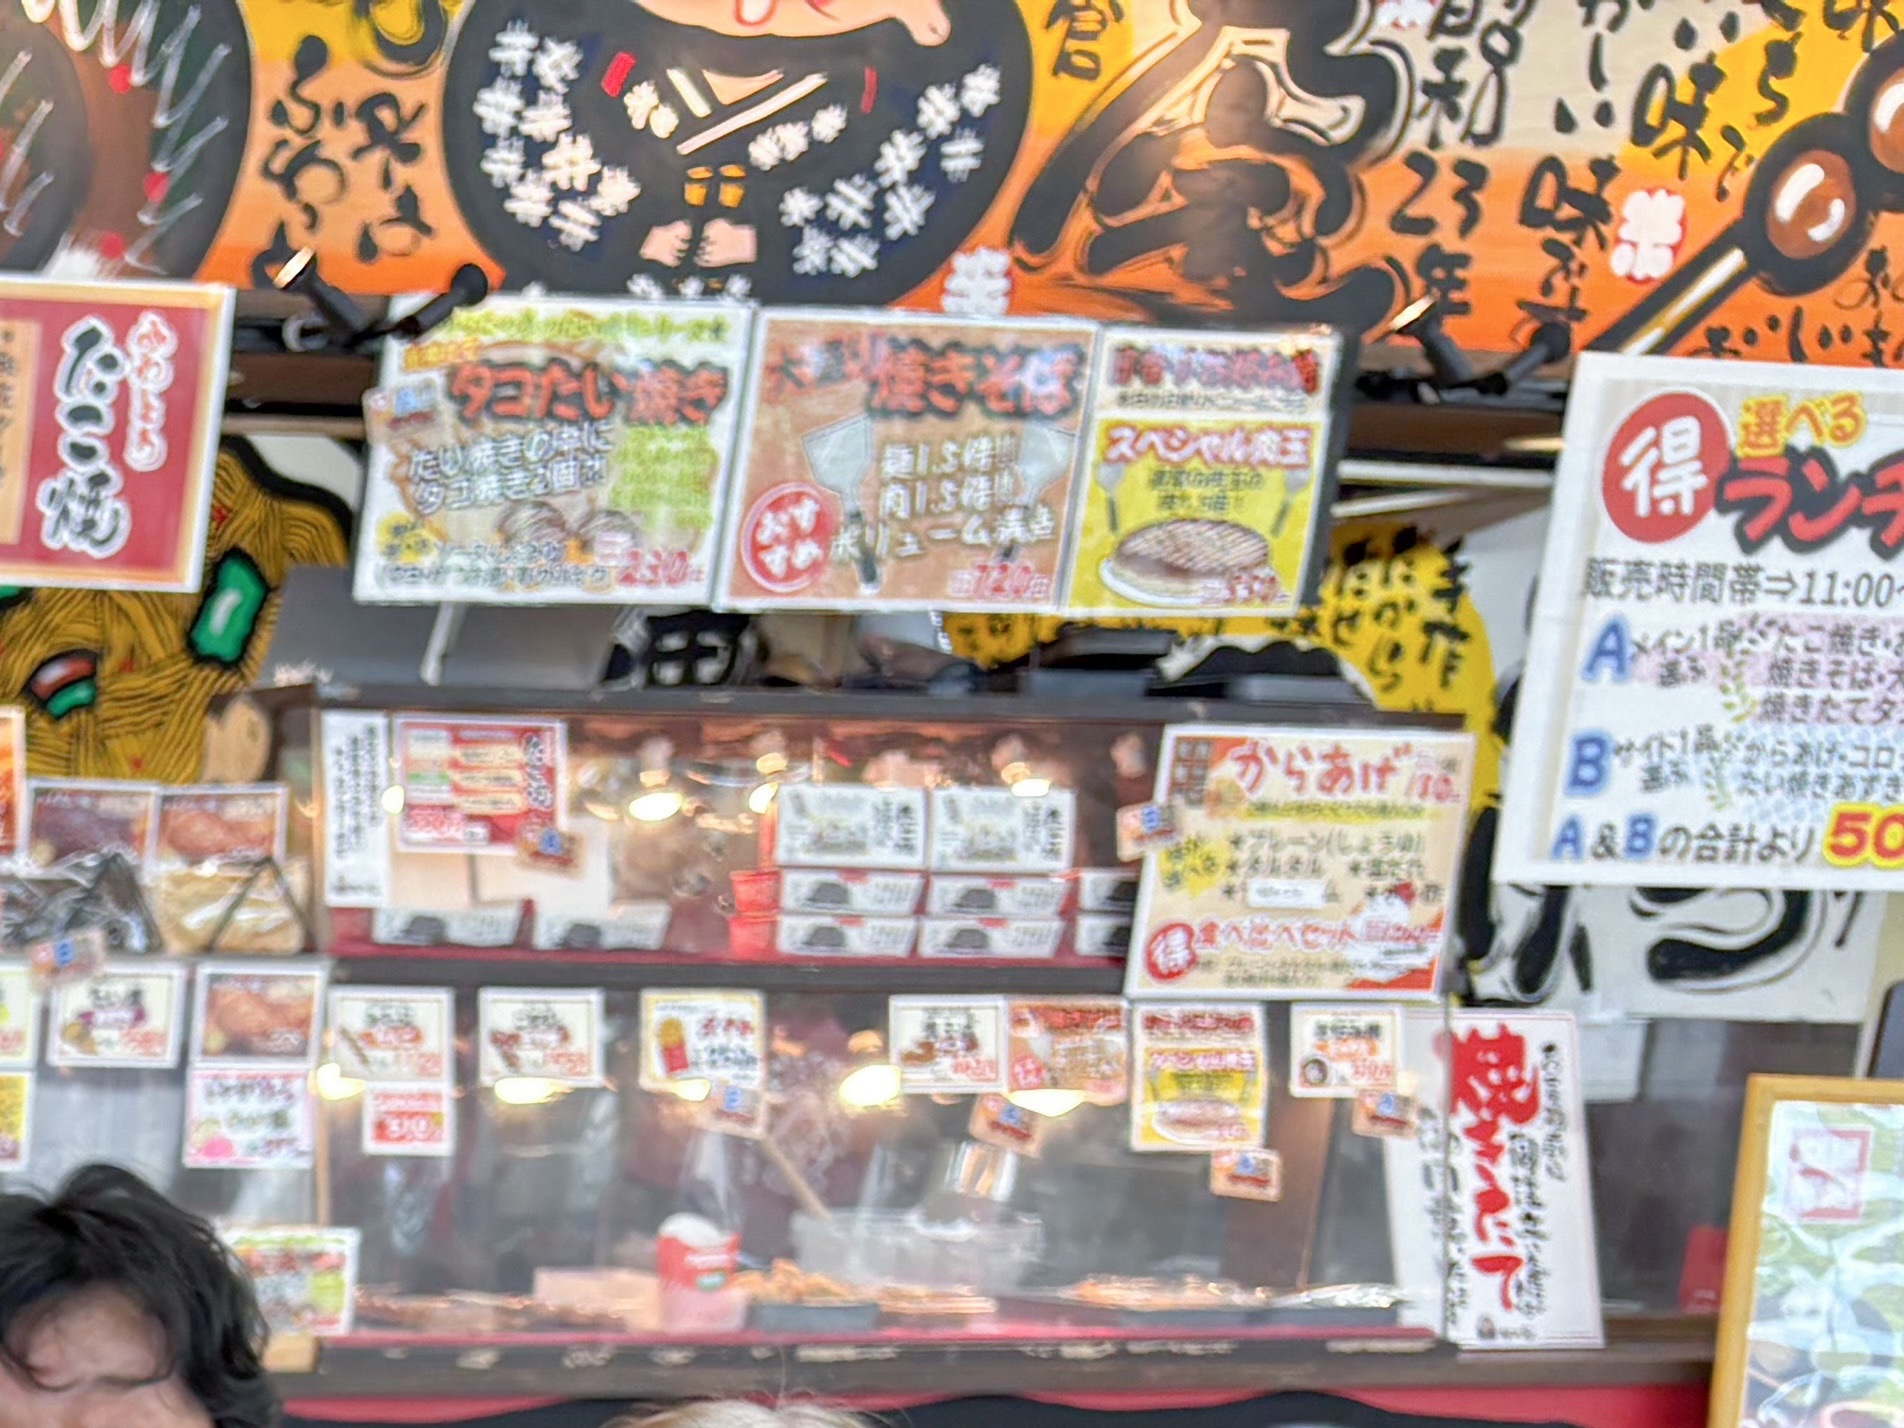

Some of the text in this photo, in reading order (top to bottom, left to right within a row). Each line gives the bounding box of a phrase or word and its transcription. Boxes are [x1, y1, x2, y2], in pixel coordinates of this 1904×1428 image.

[446, 357, 731, 428] タコたい焼き
[866, 338, 1085, 420] 焼きそば
[36, 315, 130, 556] たこ焼
[1106, 425, 1314, 468] スペシャル肉玉
[1737, 392, 1866, 456] 選べる
[1615, 414, 1709, 518] 得
[1583, 615, 1630, 682] A
[1228, 740, 1414, 795] からあげ
[1568, 733, 1613, 796] B
